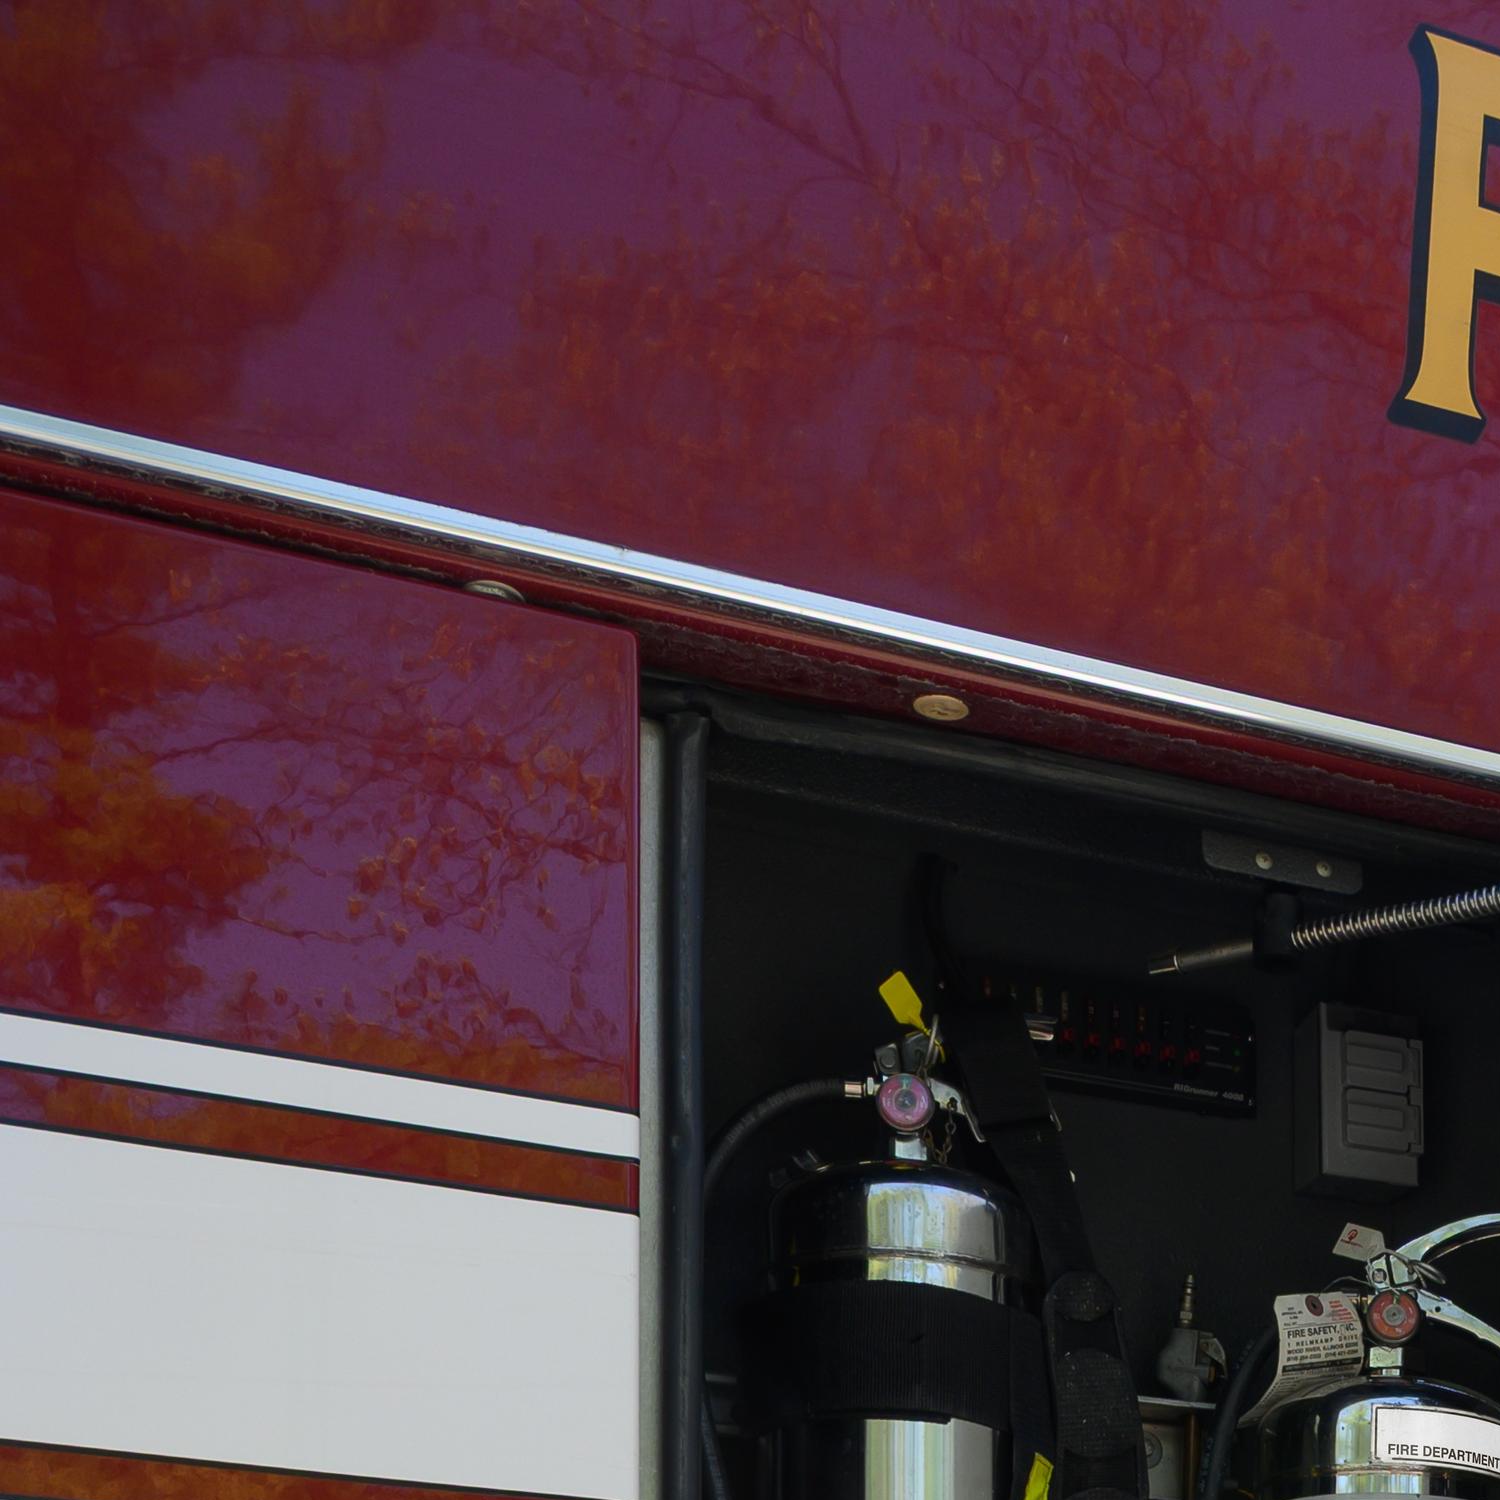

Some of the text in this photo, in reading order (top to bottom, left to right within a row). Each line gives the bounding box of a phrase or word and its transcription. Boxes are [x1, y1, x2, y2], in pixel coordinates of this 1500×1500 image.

[1287, 1328, 1305, 1339] FIRE
[1388, 1444, 1500, 1469] FIRE DEPARTMENT
